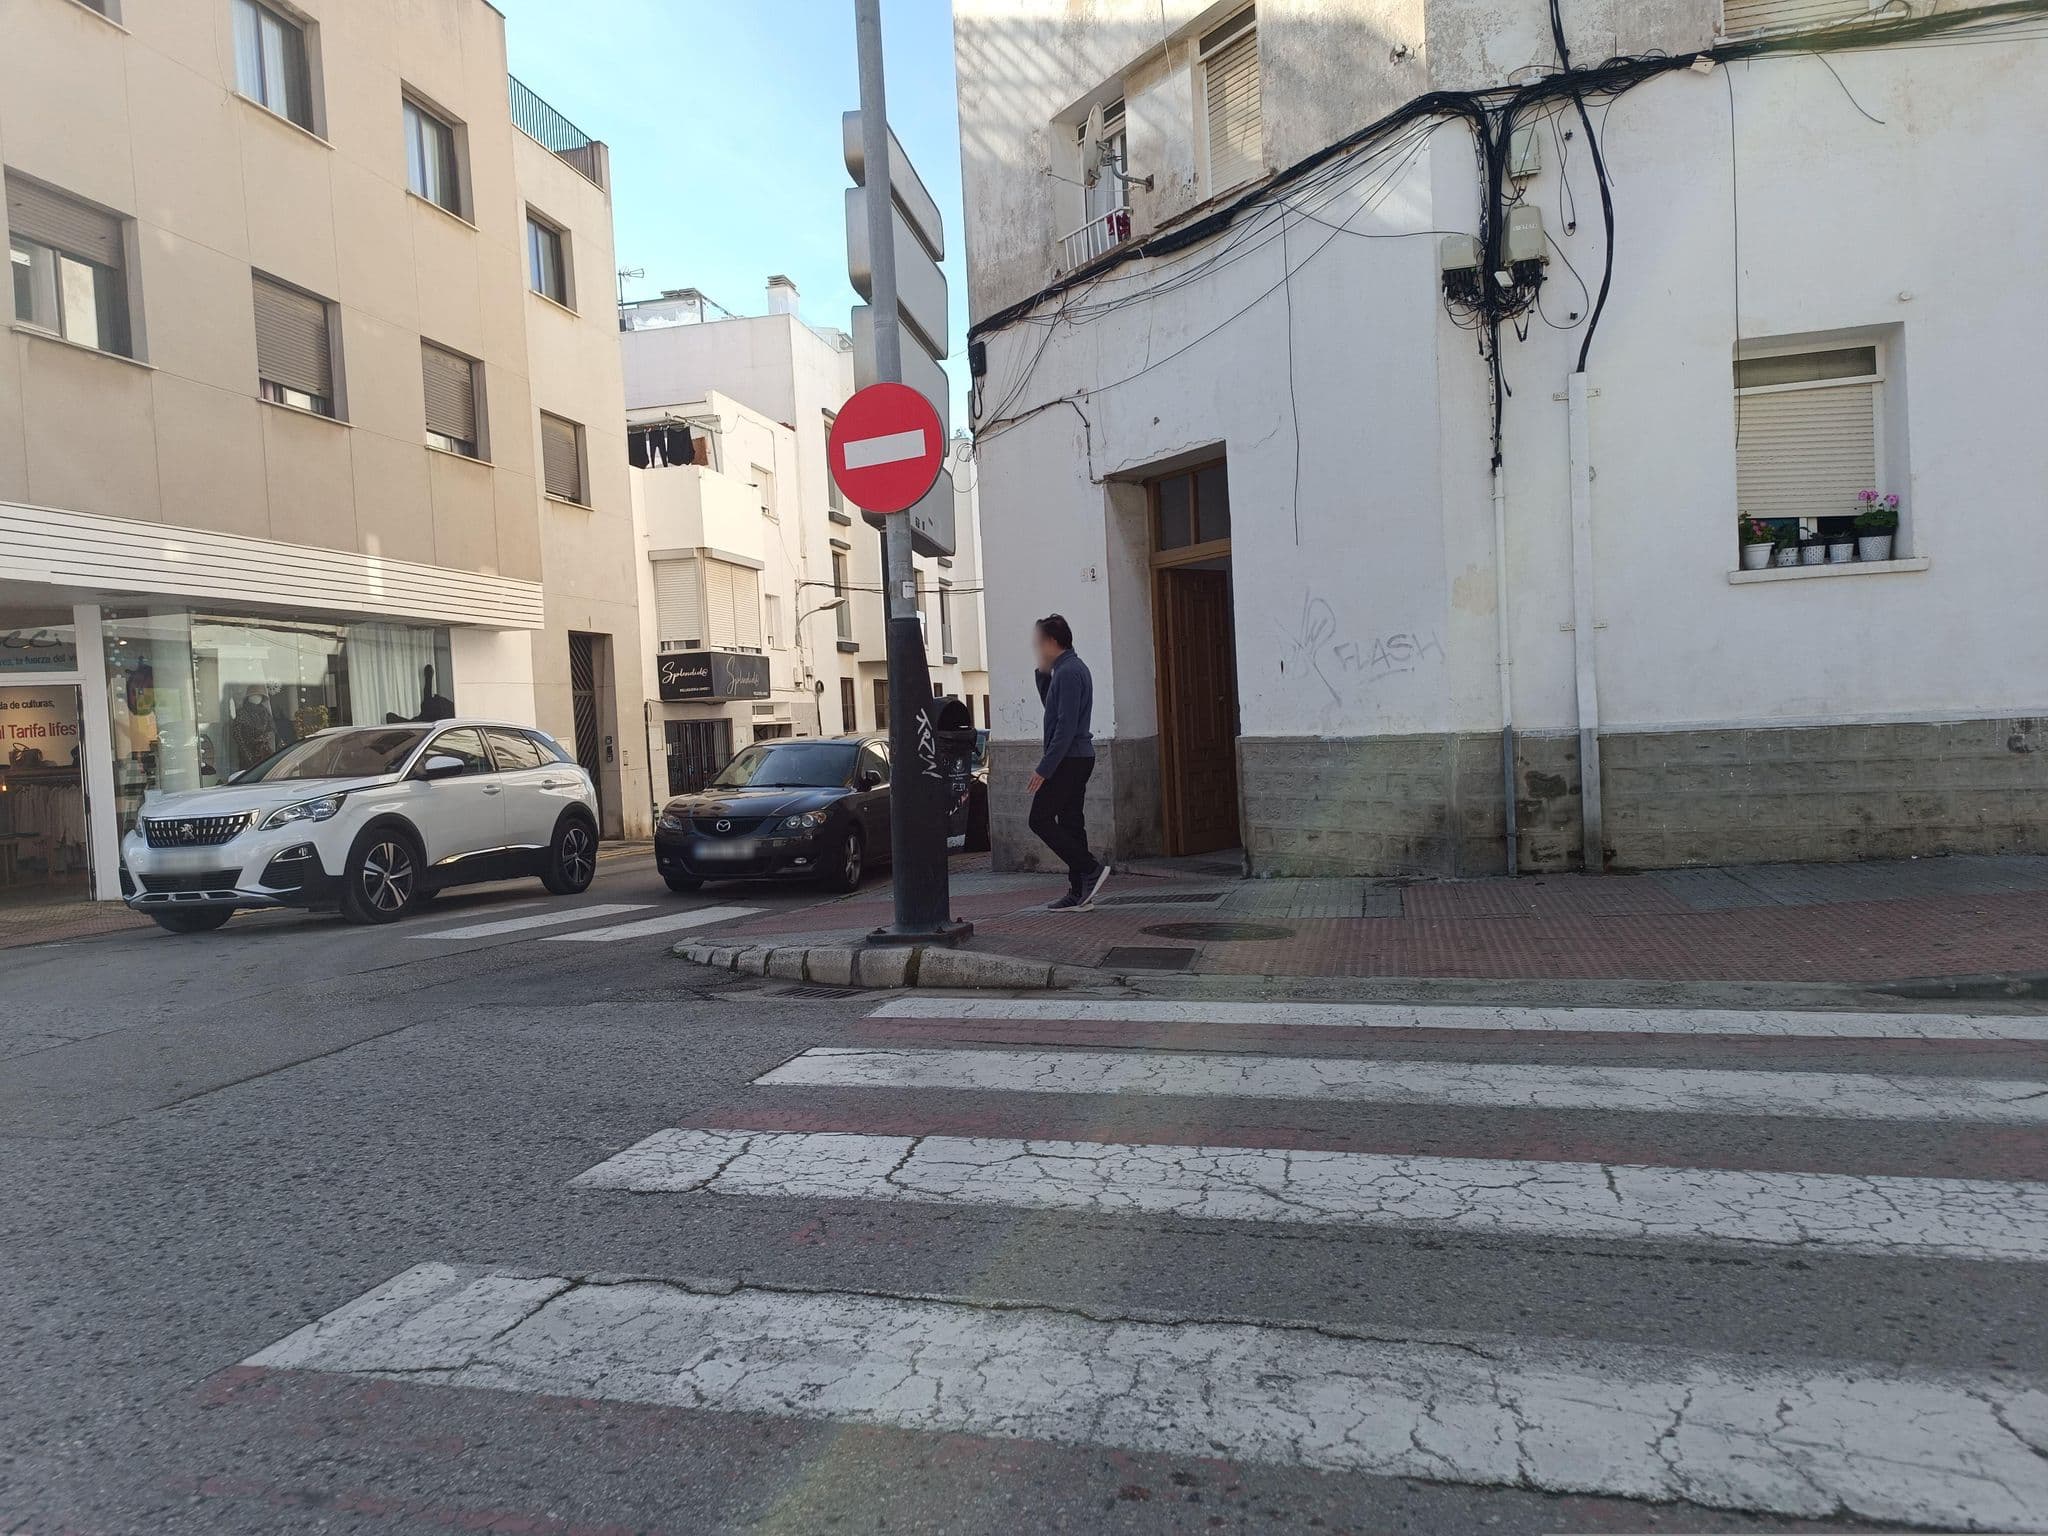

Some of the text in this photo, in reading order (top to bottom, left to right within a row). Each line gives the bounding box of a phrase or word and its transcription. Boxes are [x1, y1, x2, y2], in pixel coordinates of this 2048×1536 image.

[1333, 629, 1446, 673] FLASH
[9, 701, 20, 709] de
[8, 723, 46, 739] Tarifa
[48, 722, 77, 737] lifes
